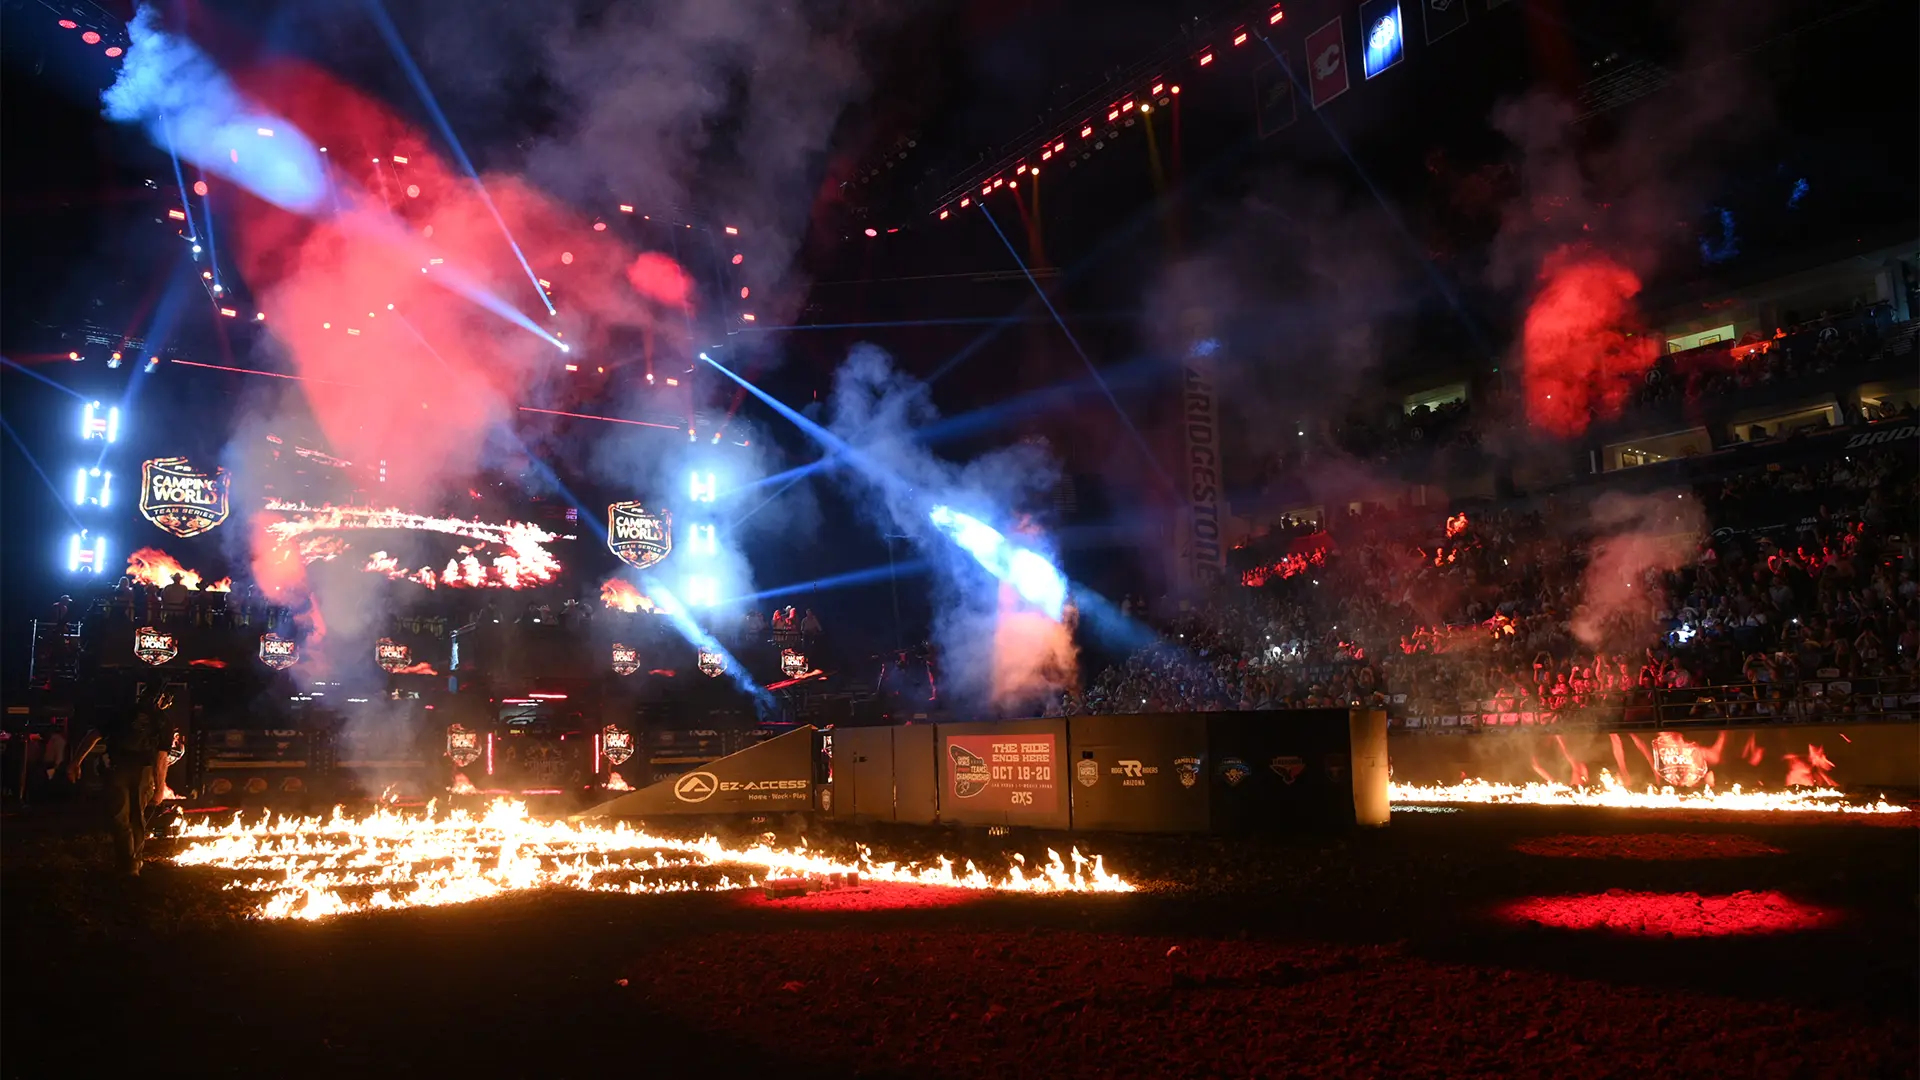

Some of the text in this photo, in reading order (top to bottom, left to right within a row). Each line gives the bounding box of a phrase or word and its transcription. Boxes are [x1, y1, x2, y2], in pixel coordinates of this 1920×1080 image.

[152, 474, 218, 491] CAMPING
[152, 486, 218, 505] WORLD
[182, 508, 215, 519] SERIES
[615, 516, 663, 530] CAMPING
[615, 526, 664, 541] WORLD
[991, 743, 1050, 753] THE RIDE
[991, 754, 1020, 762] ENDS
[1022, 754, 1050, 762] HERE
[992, 766, 1051, 781] OCT 18-20
[719, 780, 807, 791] EZ-ACCESS
[792, 792, 806, 800] Play
[1011, 791, 1033, 806] axs
